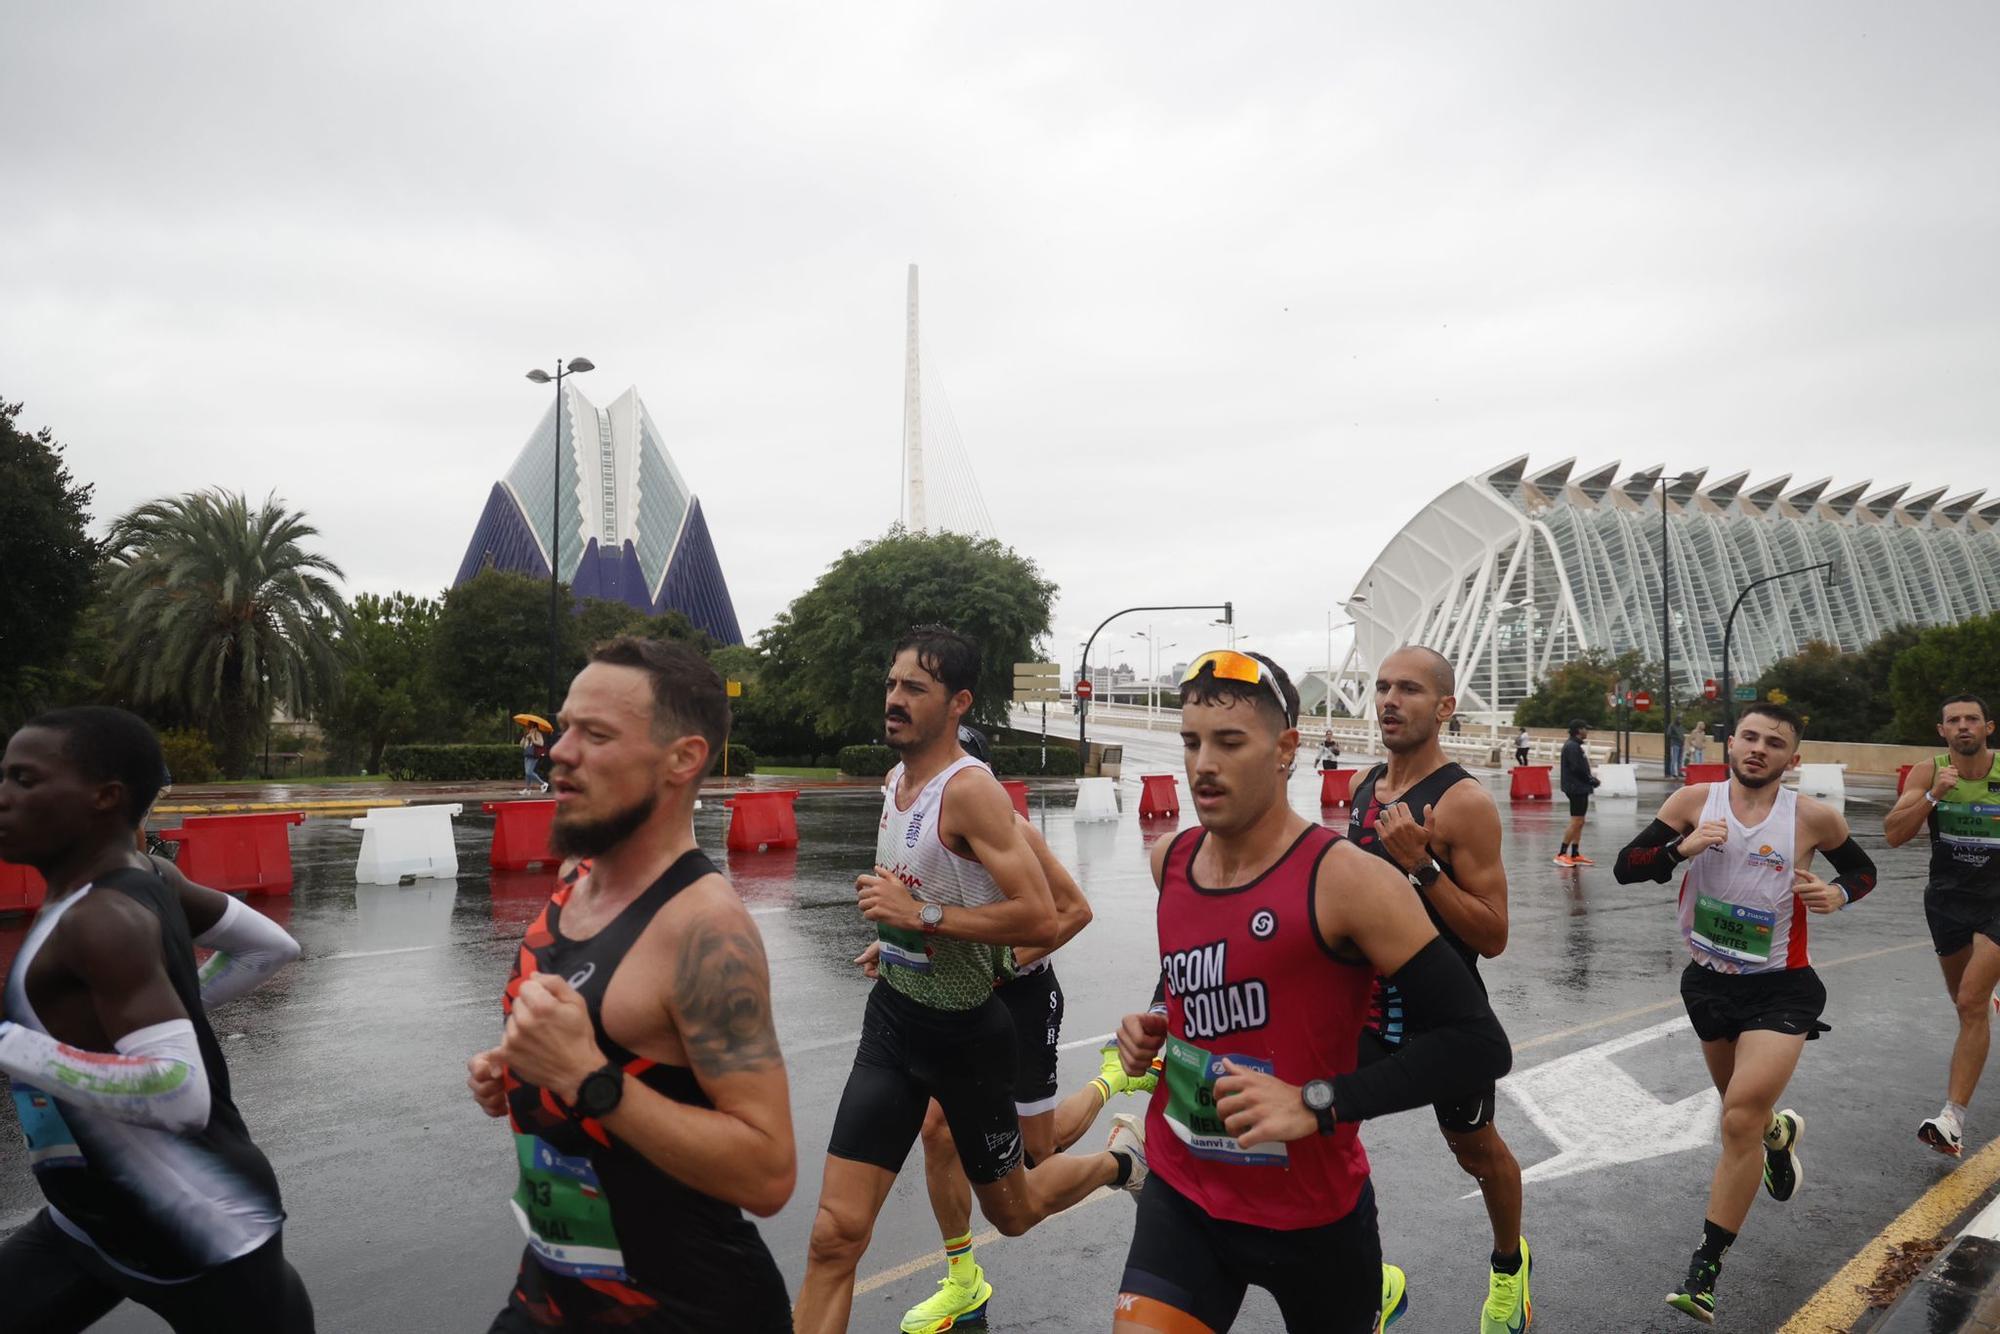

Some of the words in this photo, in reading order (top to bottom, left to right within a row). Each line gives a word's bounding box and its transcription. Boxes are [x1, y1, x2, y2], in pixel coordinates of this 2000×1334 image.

[1713, 917, 1744, 934] 1352
[1184, 982, 1266, 1038] SQUAD
[1190, 1113, 1223, 1132] MEL
